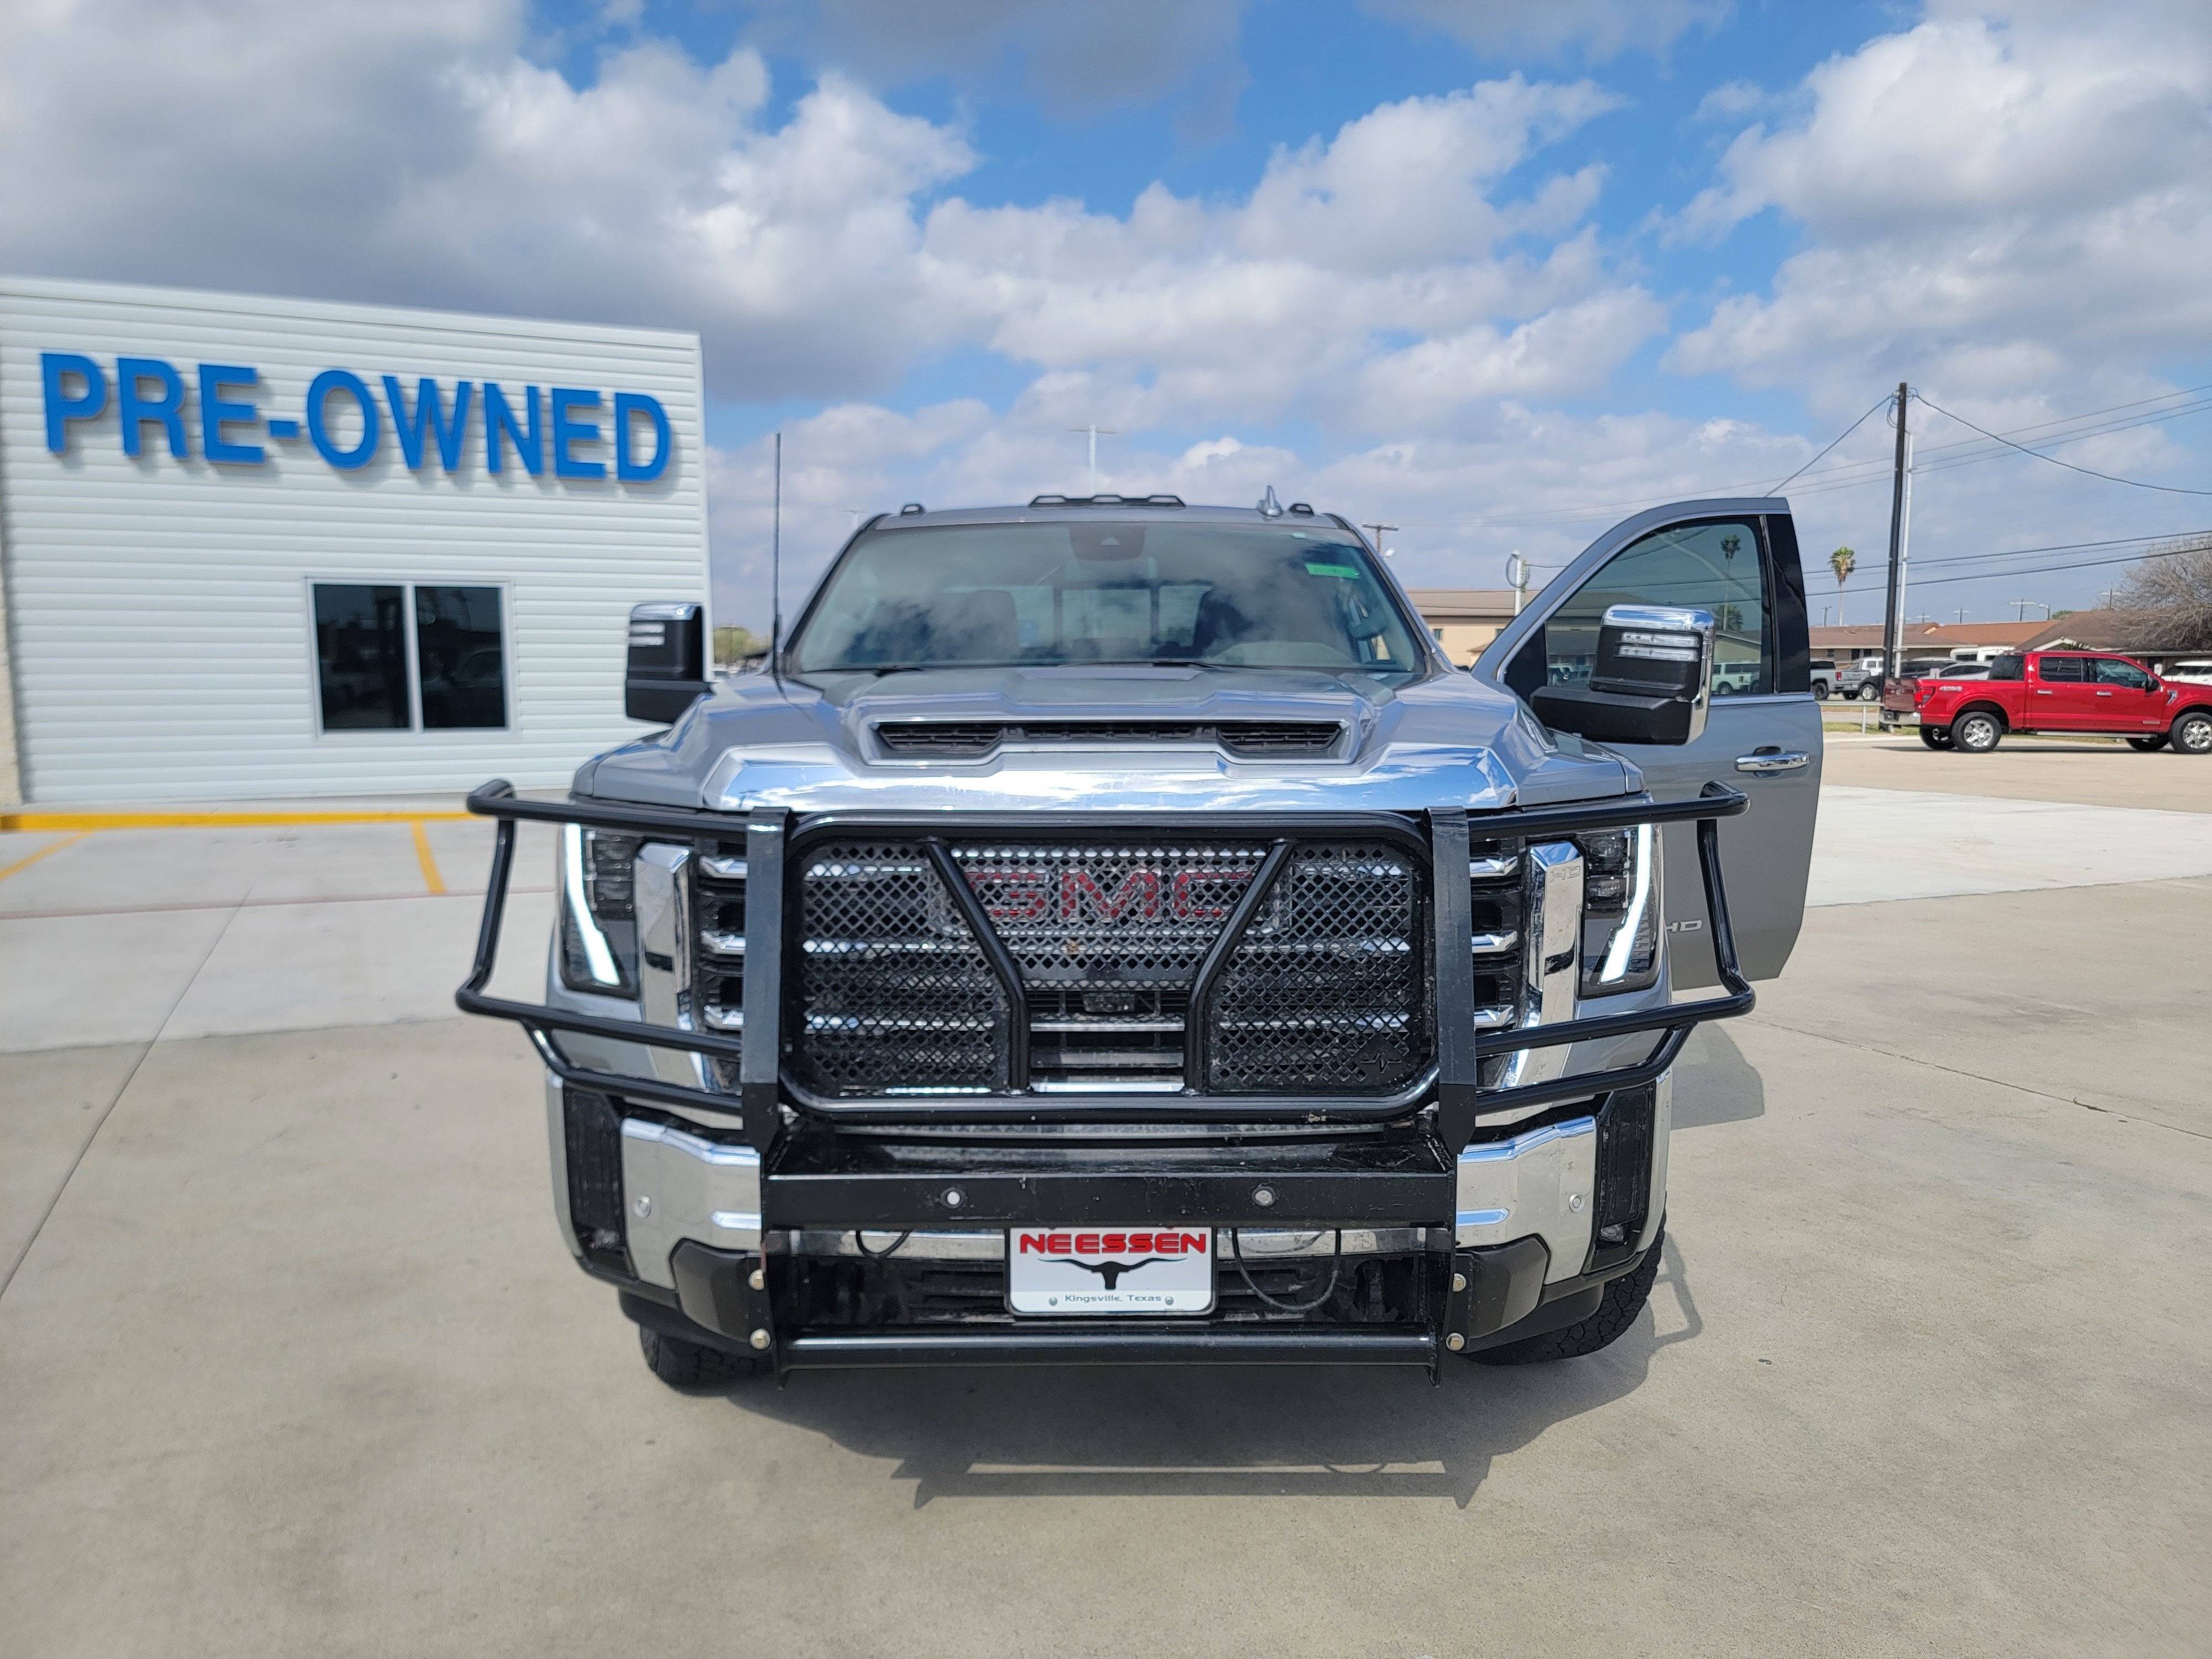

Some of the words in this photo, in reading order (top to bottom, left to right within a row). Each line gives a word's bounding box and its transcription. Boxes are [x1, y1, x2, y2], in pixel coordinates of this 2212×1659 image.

[40, 353, 670, 483] PRE-OWNED
[1550, 865, 1580, 883] HD
[966, 868, 1254, 919] GMC
[1020, 1233, 1206, 1254] NEESSEN
